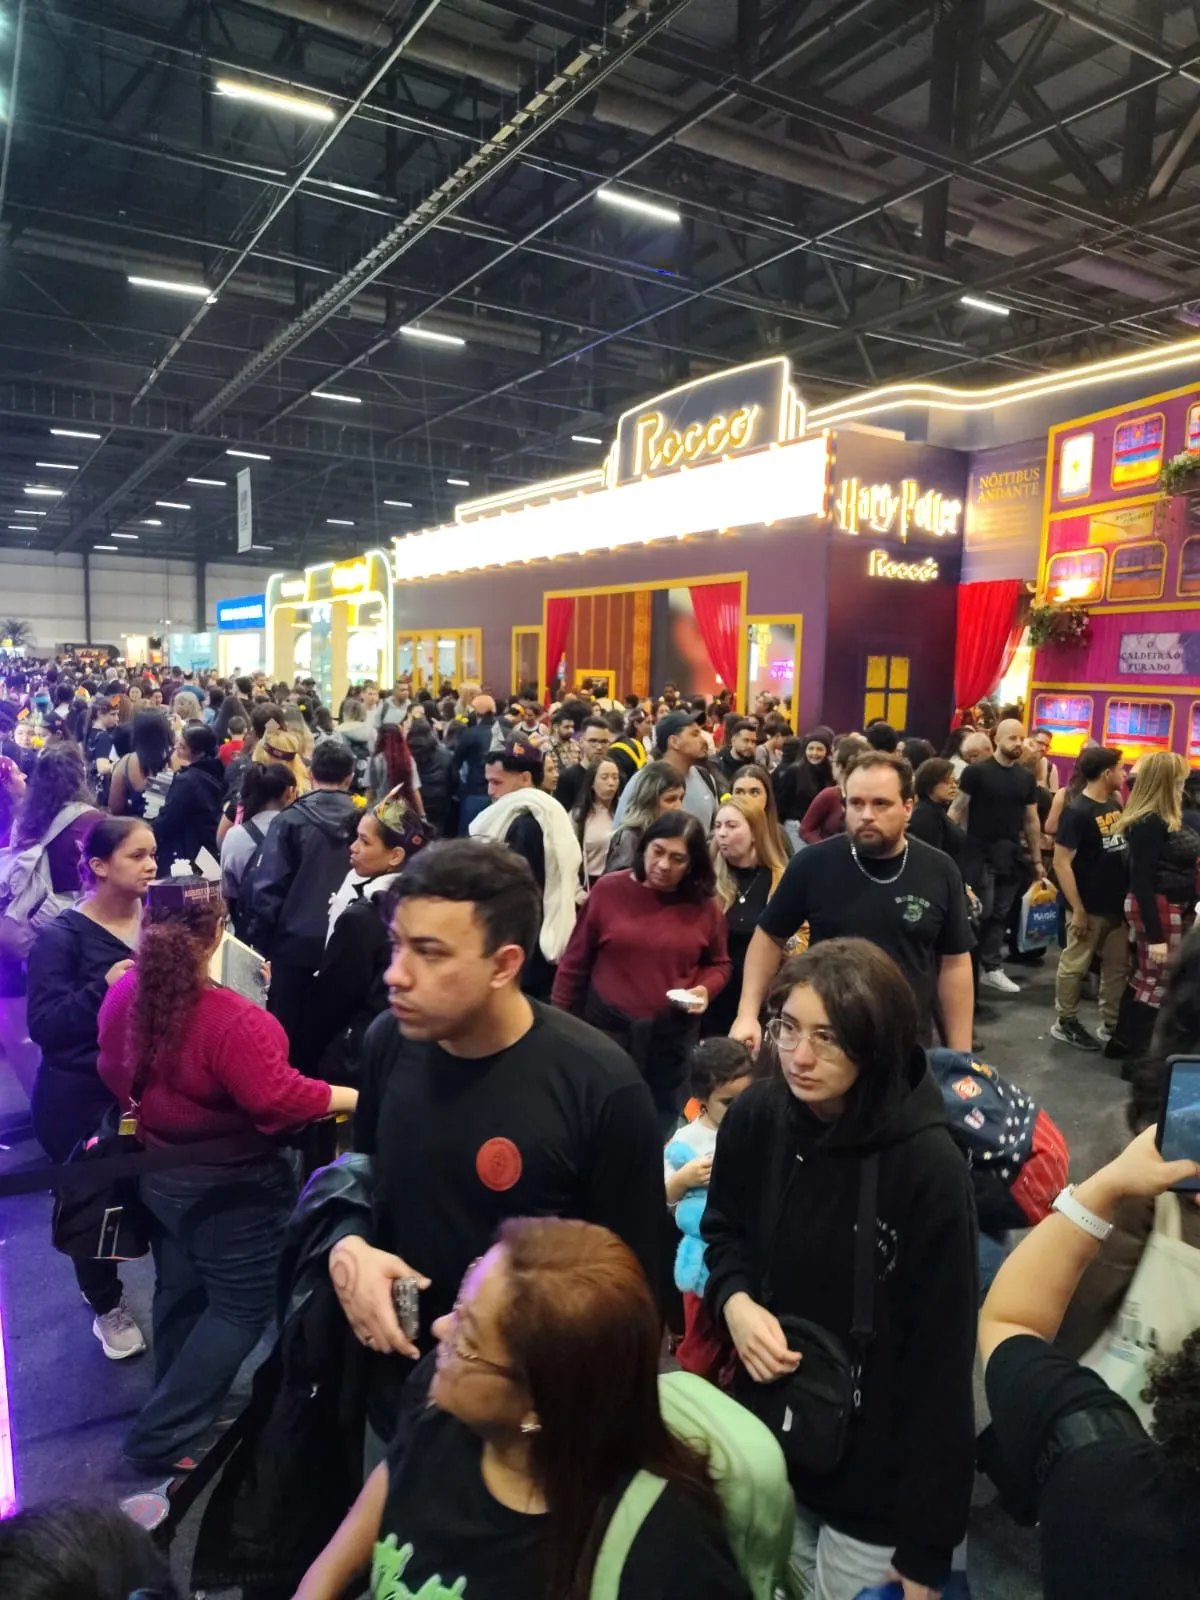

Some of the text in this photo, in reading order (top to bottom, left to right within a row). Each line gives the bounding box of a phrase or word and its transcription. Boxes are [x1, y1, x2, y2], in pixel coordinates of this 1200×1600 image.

[633, 404, 761, 476] Rocco
[836, 478, 900, 535] Harry
[901, 479, 962, 544] Potter
[977, 481, 1040, 503] ANDANTE
[1127, 663, 1171, 672] FURADO
